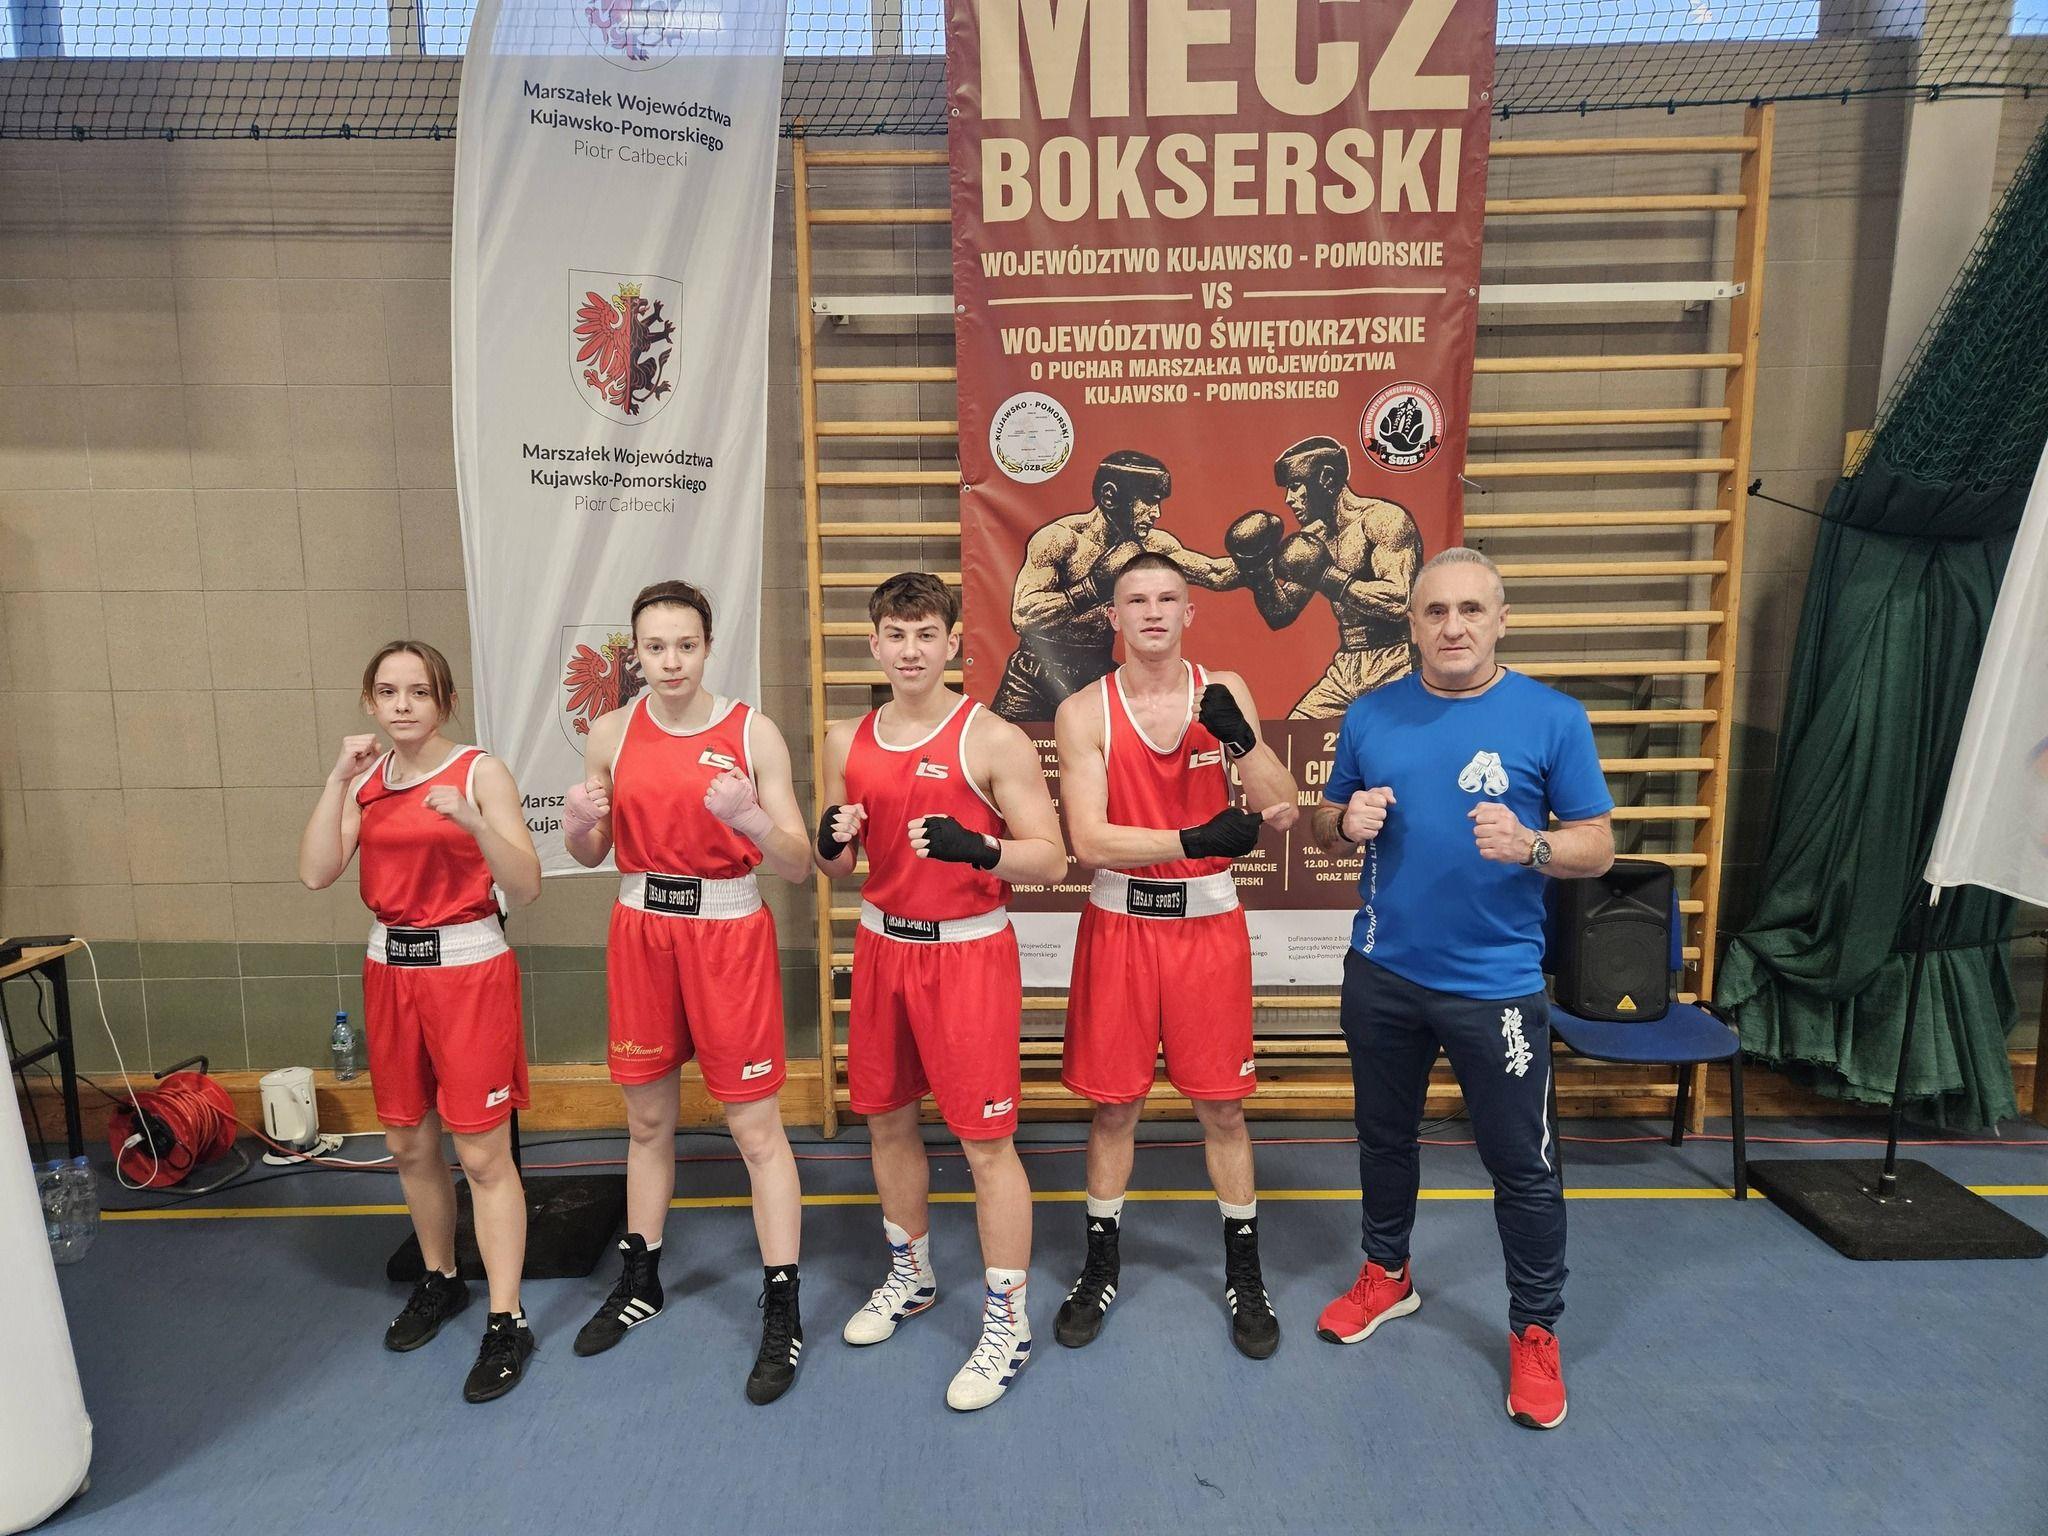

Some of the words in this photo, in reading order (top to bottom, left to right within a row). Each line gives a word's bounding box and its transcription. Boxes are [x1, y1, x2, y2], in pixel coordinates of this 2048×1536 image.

[980, 0, 1470, 120] MECZ
[523, 80, 612, 107] Marszałek
[617, 92, 732, 127] Województwa
[530, 109, 724, 152] Kujawsko-Pomorskiego
[574, 140, 613, 160] Piotr
[618, 145, 688, 167] Całbecki
[981, 128, 1462, 223] BOKSERSKI
[981, 245, 1160, 278] WOJEWÓDZTWO
[1166, 244, 1293, 273] KUJAWSKO
[1314, 241, 1444, 269] POMORSKIE
[1201, 282, 1233, 309] VS
[1001, 320, 1202, 354] WOJEWÓDZTWO
[1209, 316, 1426, 352] ŚWIĘTOKRZYSKIE
[1030, 362, 1043, 380] O
[1048, 360, 1124, 380] PUCHAR
[1128, 357, 1242, 378] MARSZAŁKA
[1247, 351, 1397, 375] WOJEWÓDZTWA
[1084, 384, 1187, 405] KUJAWSKO
[1206, 380, 1340, 402] POMORSKIEGO
[995, 401, 1028, 441] KUJAWSKO
[1035, 401, 1070, 439] POMORSKI
[522, 443, 611, 462] Marszałek
[613, 447, 713, 468] Województwa
[530, 469, 707, 493] Kujawsko-Pomorskiego
[574, 496, 608, 512] Piotr
[609, 496, 675, 513] Całbecki
[1304, 859, 1329, 868] 12.00
[1316, 872, 1342, 881] ORAZ
[668, 889, 695, 906] SPORTS
[1132, 888, 1154, 907] IHSAN
[1155, 892, 1181, 909] SPORTS
[1362, 904, 1377, 954] BOXING
